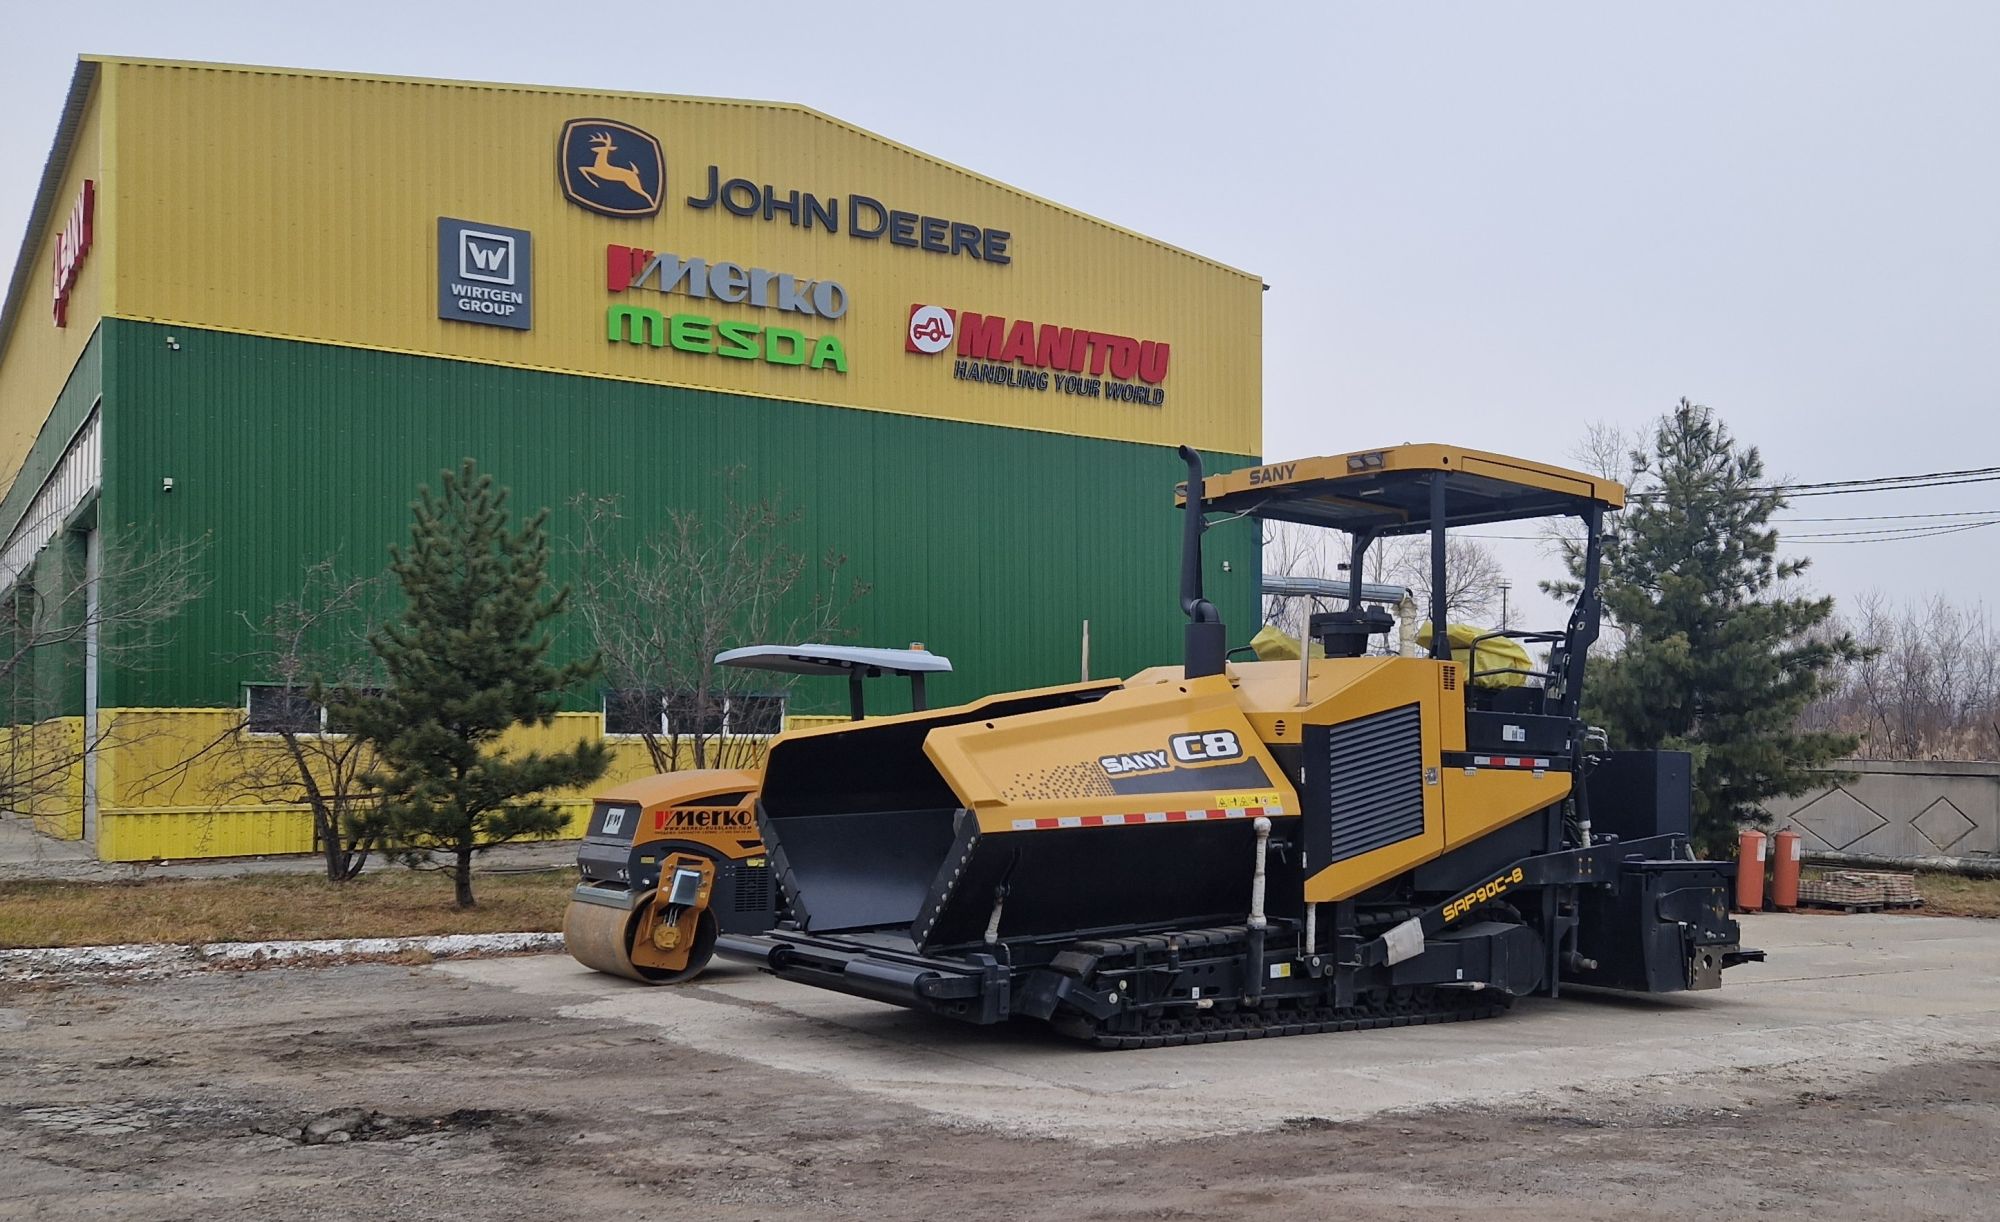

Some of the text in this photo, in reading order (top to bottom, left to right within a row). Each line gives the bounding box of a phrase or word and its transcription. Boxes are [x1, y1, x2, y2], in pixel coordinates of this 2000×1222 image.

[687, 165, 1012, 264] JOHN DEERE
[451, 283, 523, 304] WIRTGEN
[458, 298, 516, 316] GROUP
[607, 304, 848, 373] MESDA
[957, 311, 1170, 384] MANITOU
[953, 360, 1165, 406] HANDLING YOUR WORLD
[1249, 463, 1297, 486] SANY
[1101, 732, 1239, 773] SANY C8
[1442, 867, 1524, 922] SAP90C-8
